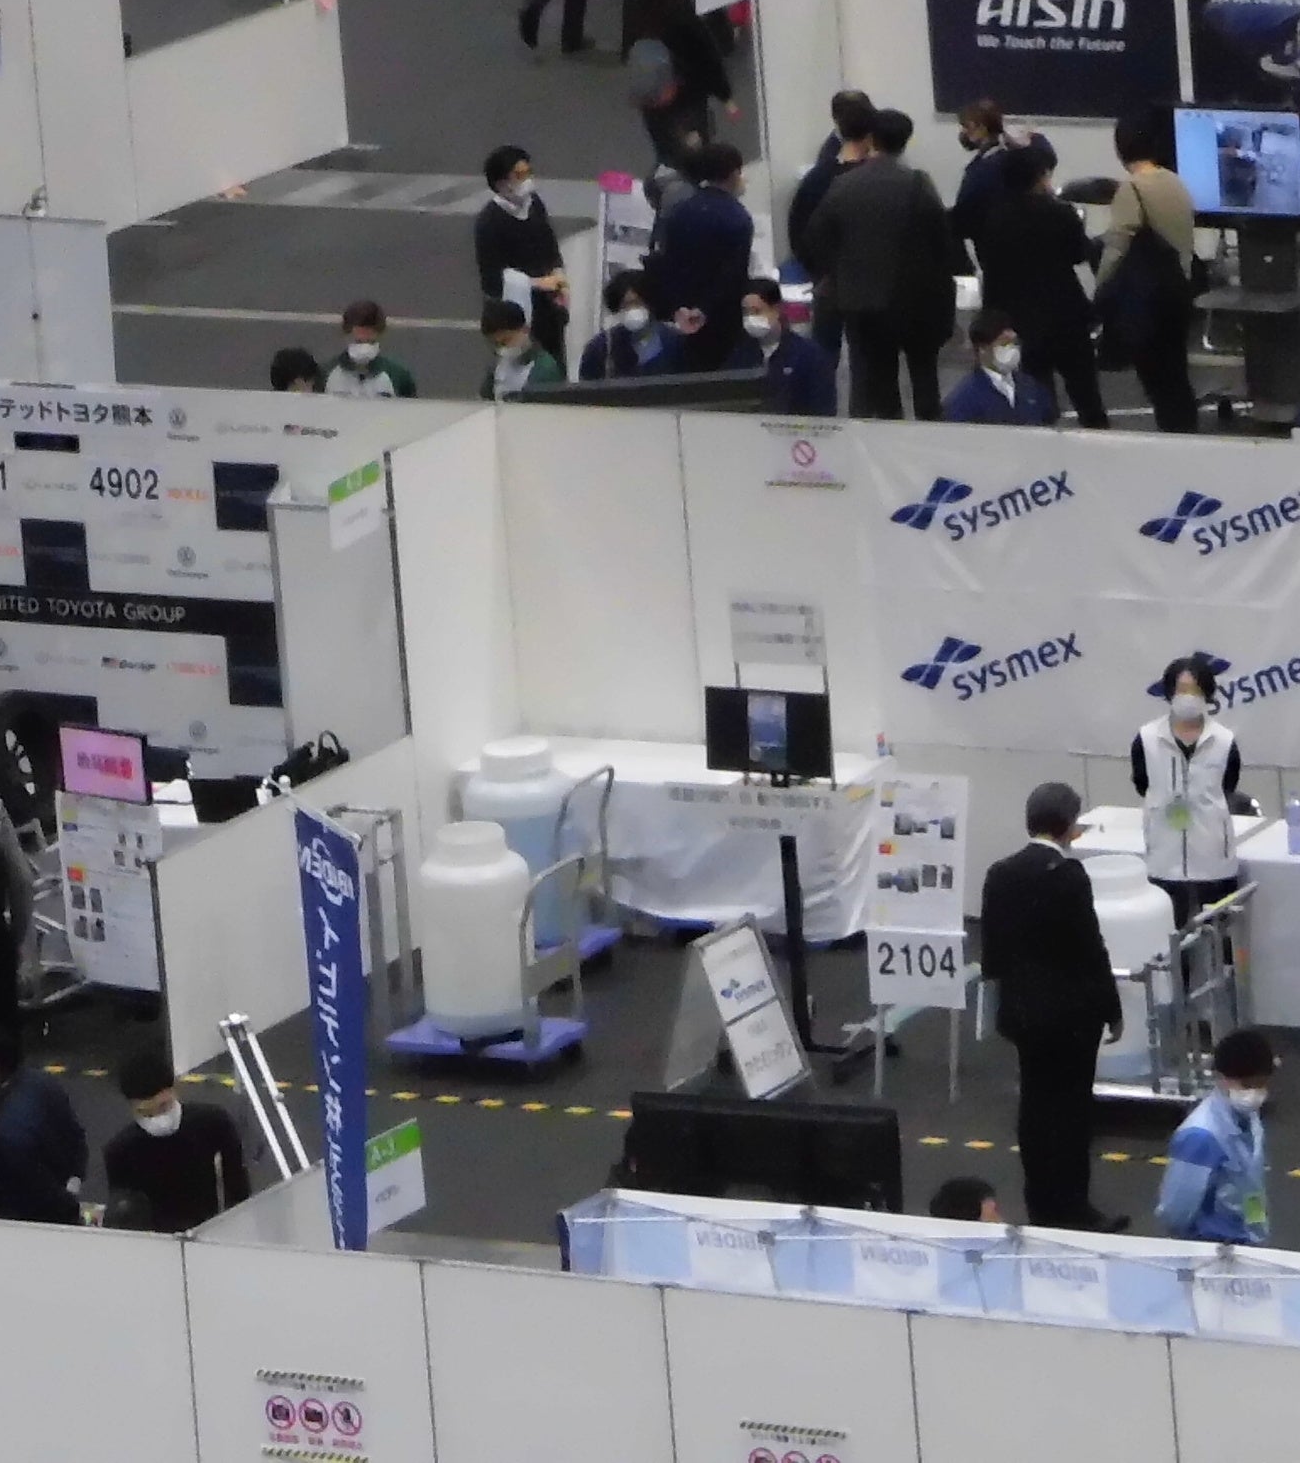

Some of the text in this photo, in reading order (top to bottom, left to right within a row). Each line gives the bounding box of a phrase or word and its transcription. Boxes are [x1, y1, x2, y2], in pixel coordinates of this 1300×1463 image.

[89, 466, 160, 501] 4902
[943, 469, 1076, 542] sysmex
[46, 597, 117, 620] TOYOTA
[122, 602, 187, 624] GROUP
[953, 629, 1084, 702] sysmex
[877, 940, 959, 978] 2104
